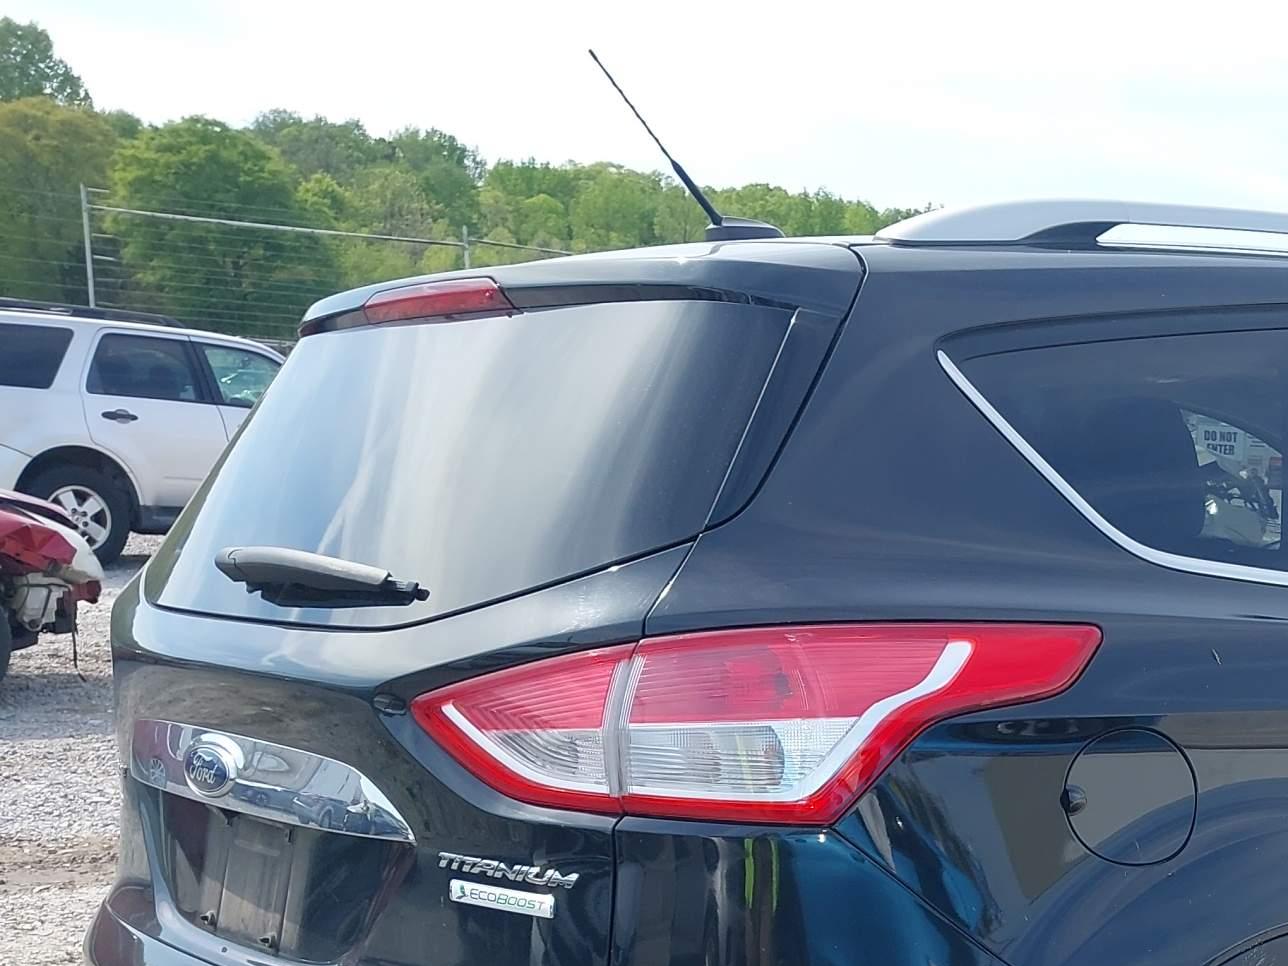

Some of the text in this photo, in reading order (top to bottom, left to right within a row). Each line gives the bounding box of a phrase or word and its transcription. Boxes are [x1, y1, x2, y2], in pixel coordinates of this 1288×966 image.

[1203, 430, 1238, 443] DO NOT
[189, 751, 217, 784] Ford
[437, 851, 580, 889] TITANIUM
